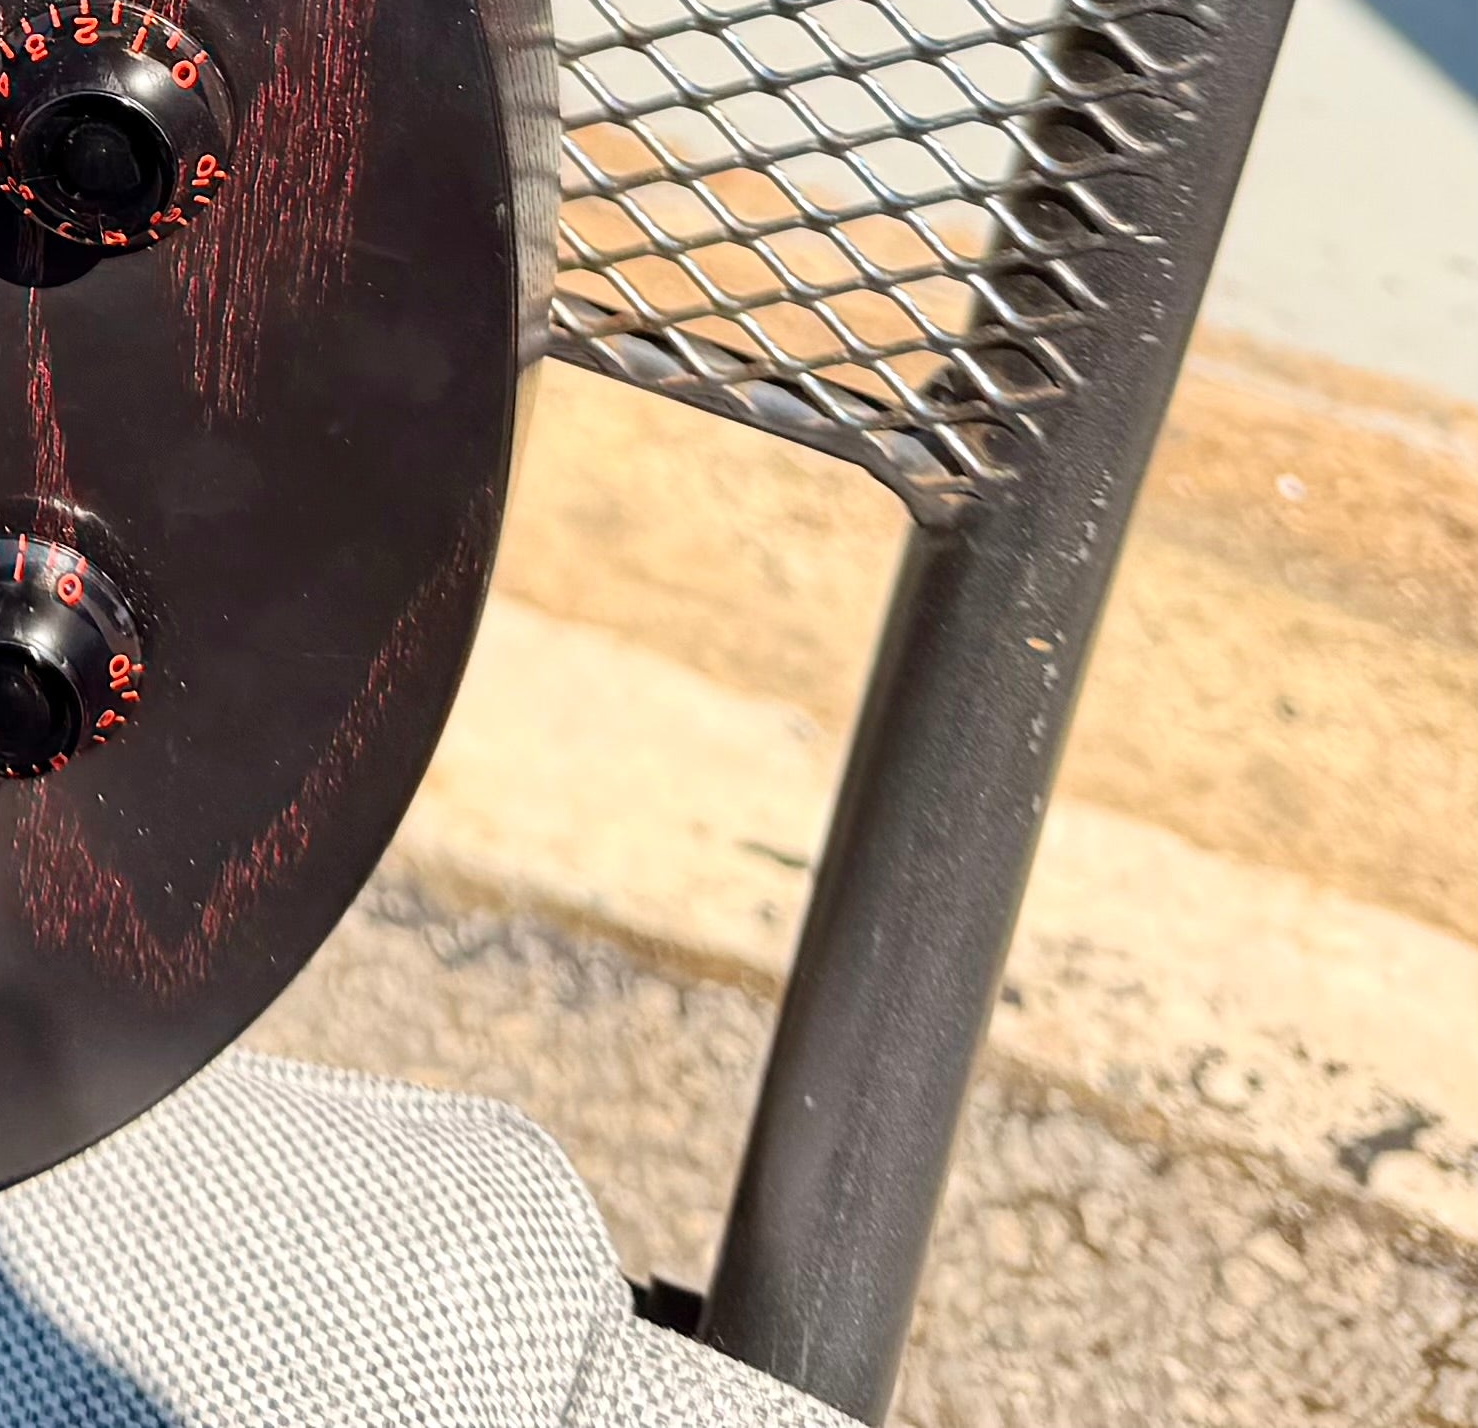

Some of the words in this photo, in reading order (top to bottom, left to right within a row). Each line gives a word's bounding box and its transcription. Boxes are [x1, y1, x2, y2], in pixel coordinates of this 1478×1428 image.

[73, 17, 99, 45] 2
[172, 59, 198, 89] 0
[192, 154, 218, 186] 10
[57, 572, 84, 607] 0
[109, 653, 131, 691] 10
